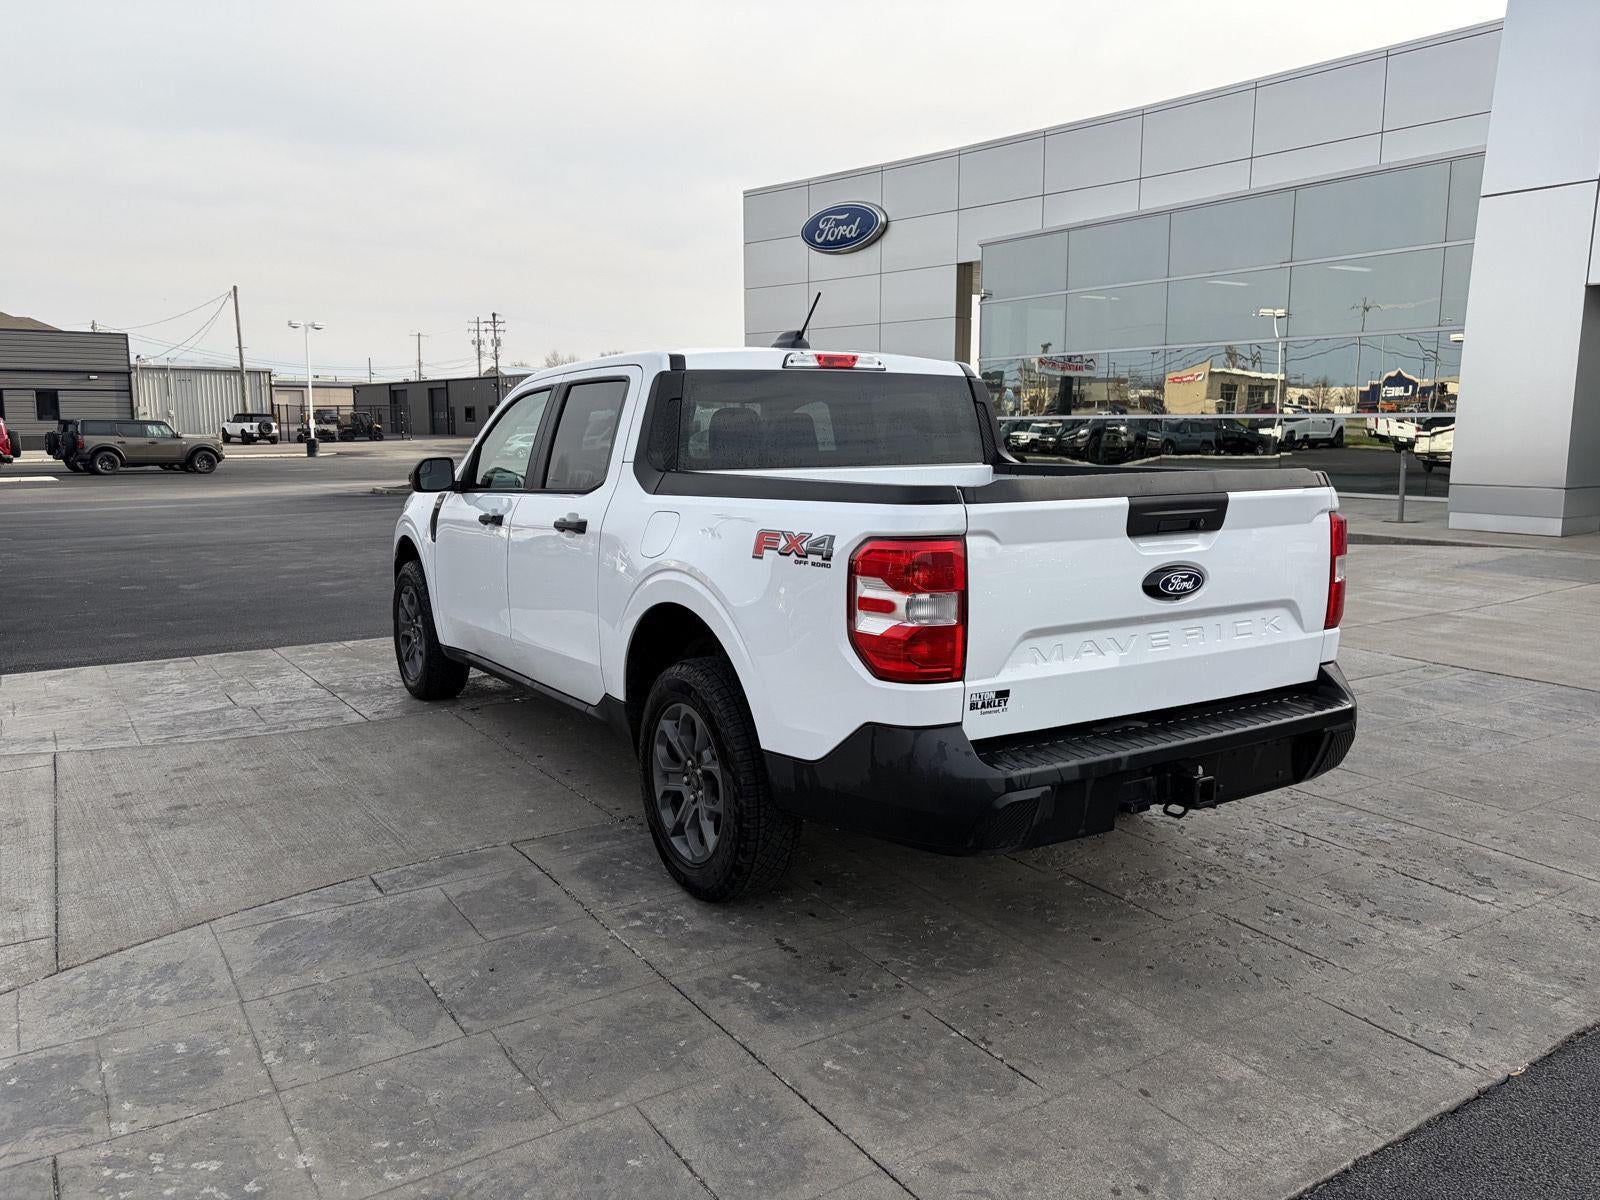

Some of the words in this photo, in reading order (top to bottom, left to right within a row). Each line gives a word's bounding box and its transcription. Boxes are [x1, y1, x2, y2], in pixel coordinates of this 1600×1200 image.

[815, 213, 861, 243] Ford
[752, 528, 836, 561] FX4
[811, 561, 832, 569] ROAD
[1168, 574, 1195, 591] Ford
[1029, 615, 1284, 666] MAVERICK
[969, 698, 1008, 711] BLAKLEY
[970, 690, 995, 702] ALTON
